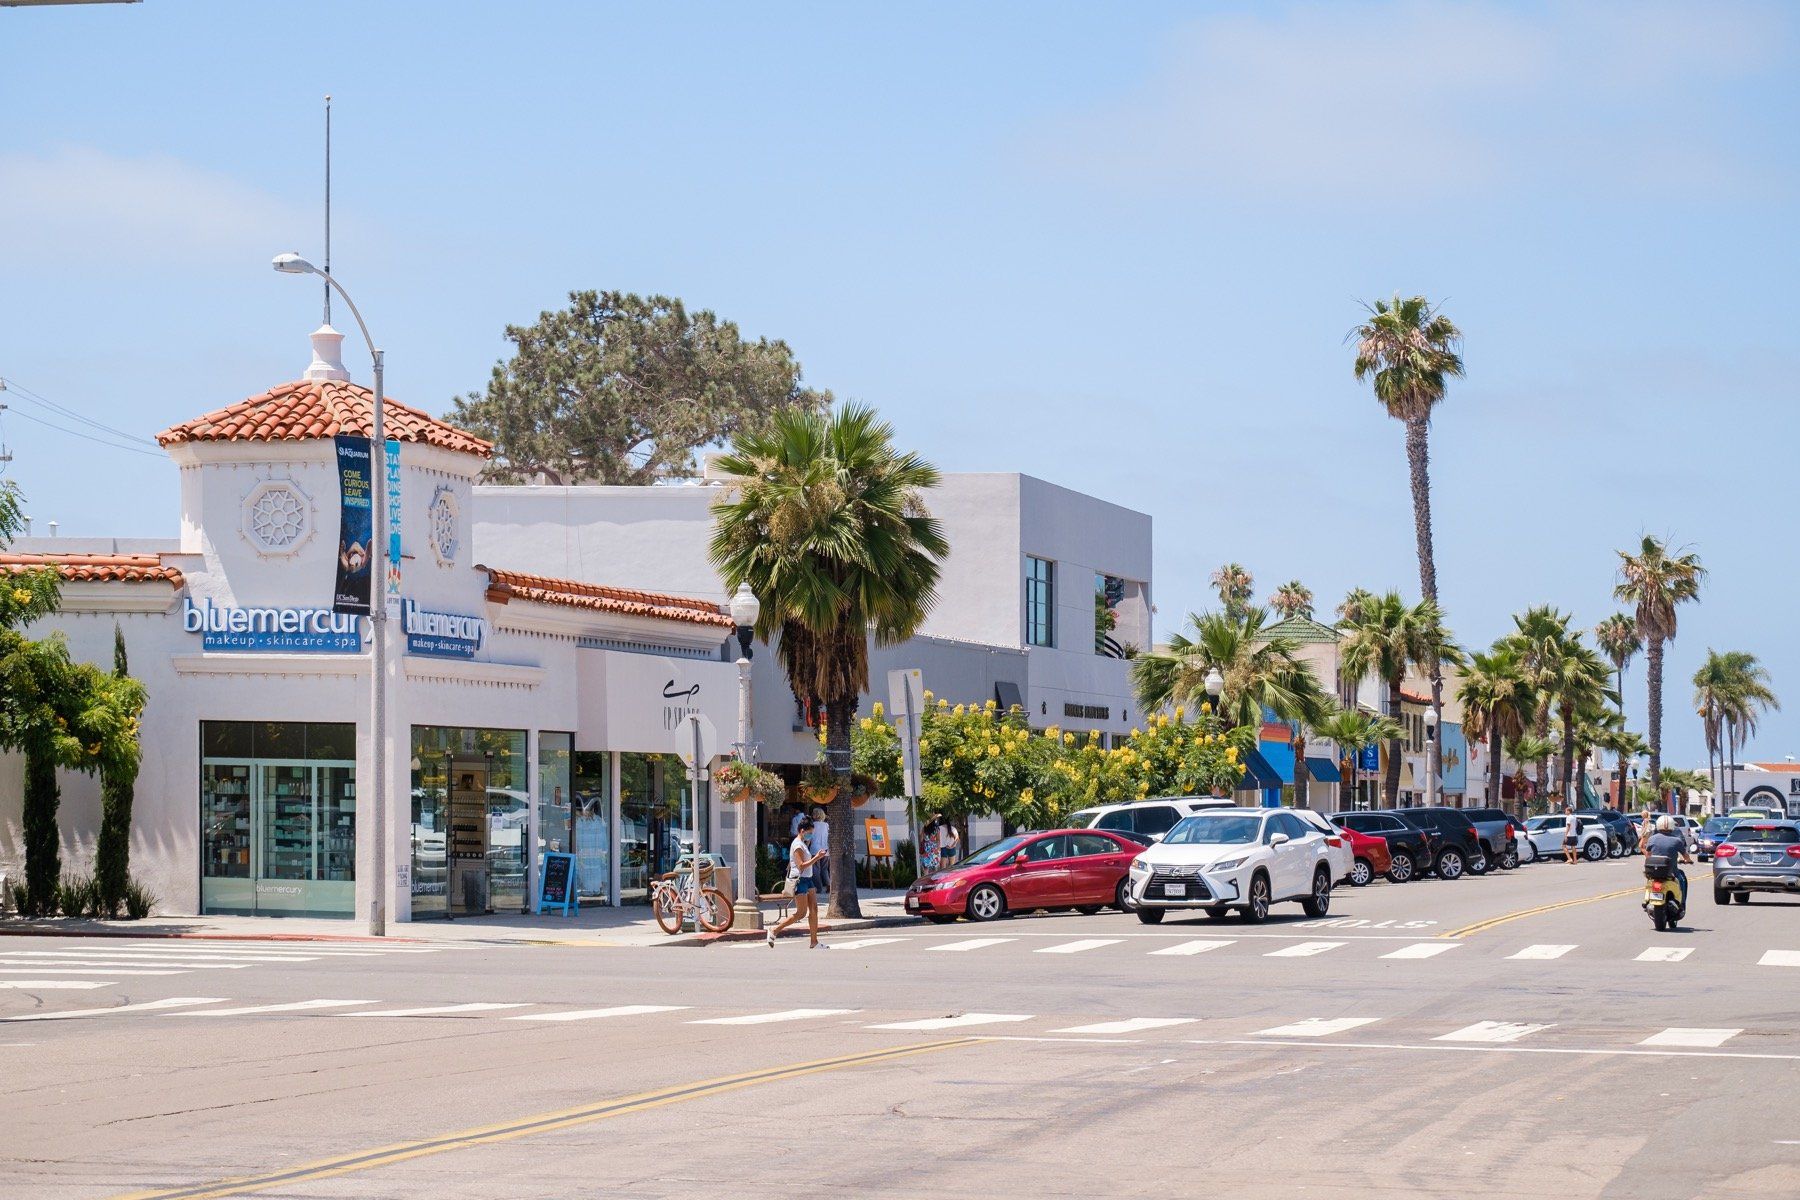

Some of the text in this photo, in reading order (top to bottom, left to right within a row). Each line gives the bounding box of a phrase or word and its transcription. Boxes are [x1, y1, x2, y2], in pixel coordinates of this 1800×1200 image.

[343, 470, 361, 479] COME
[344, 488, 362, 497] LEAVE
[404, 599, 488, 650] bluemercury
[205, 635, 356, 648] makeup skincare spa
[412, 638, 474, 654] makeup skincare spa
[256, 884, 303, 895] bluemercury
[1291, 919, 1439, 929] STOP
